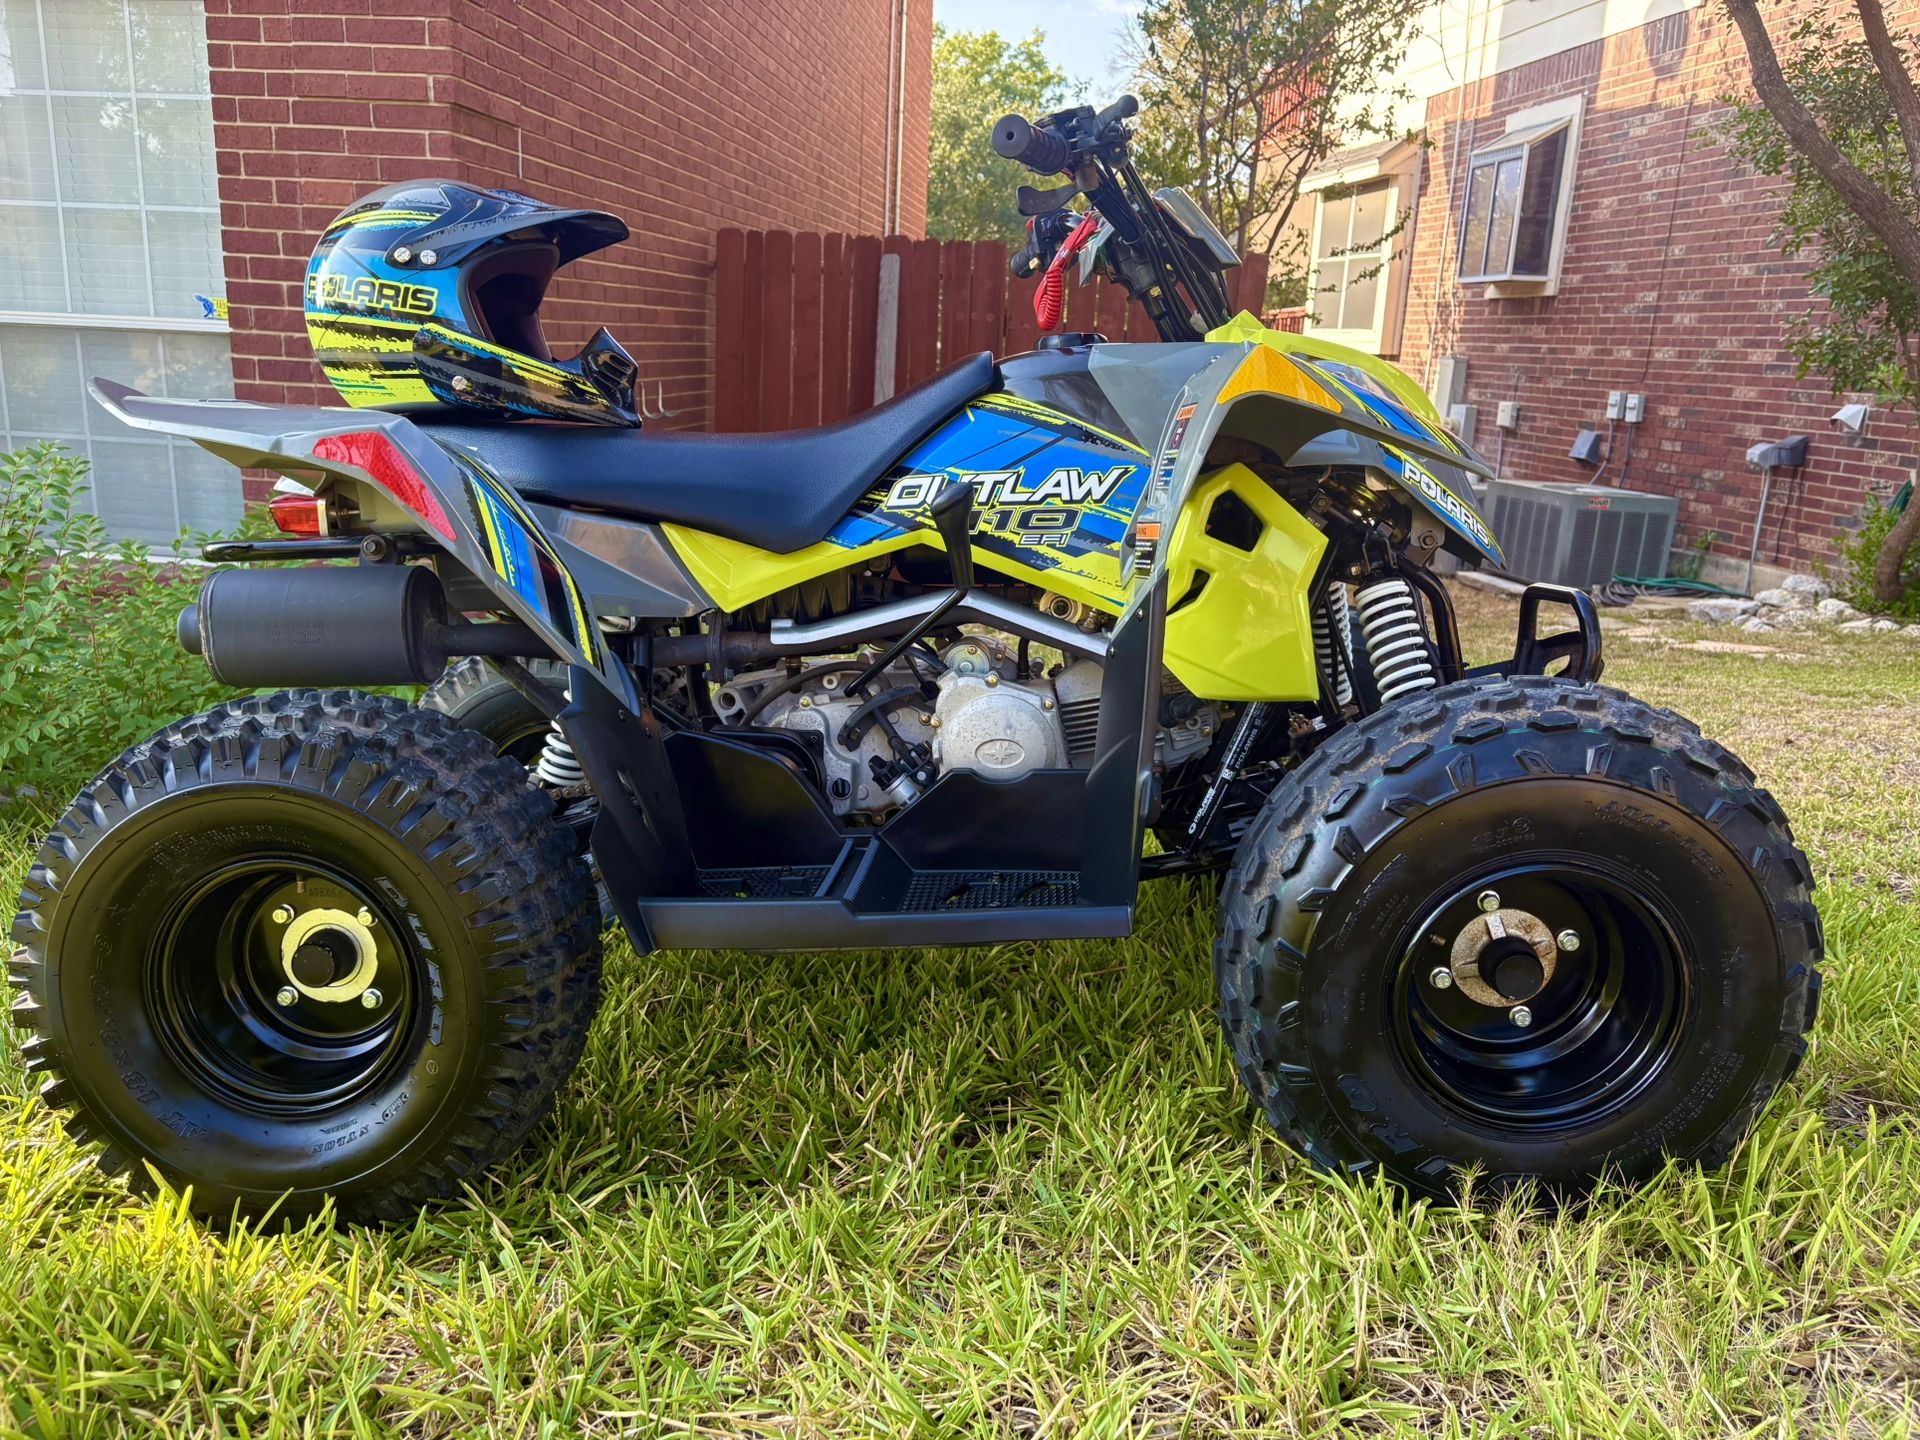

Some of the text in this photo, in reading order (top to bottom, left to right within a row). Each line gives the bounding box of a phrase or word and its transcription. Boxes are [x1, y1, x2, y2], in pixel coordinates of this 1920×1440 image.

[307, 273, 437, 315] POLARIS
[1403, 460, 1490, 546] POLARIS
[1020, 533, 1069, 547] EFI
[1235, 728, 1258, 769] POLARIS
[1194, 786, 1215, 823] POLARIS
[310, 1123, 370, 1155] NYLON
